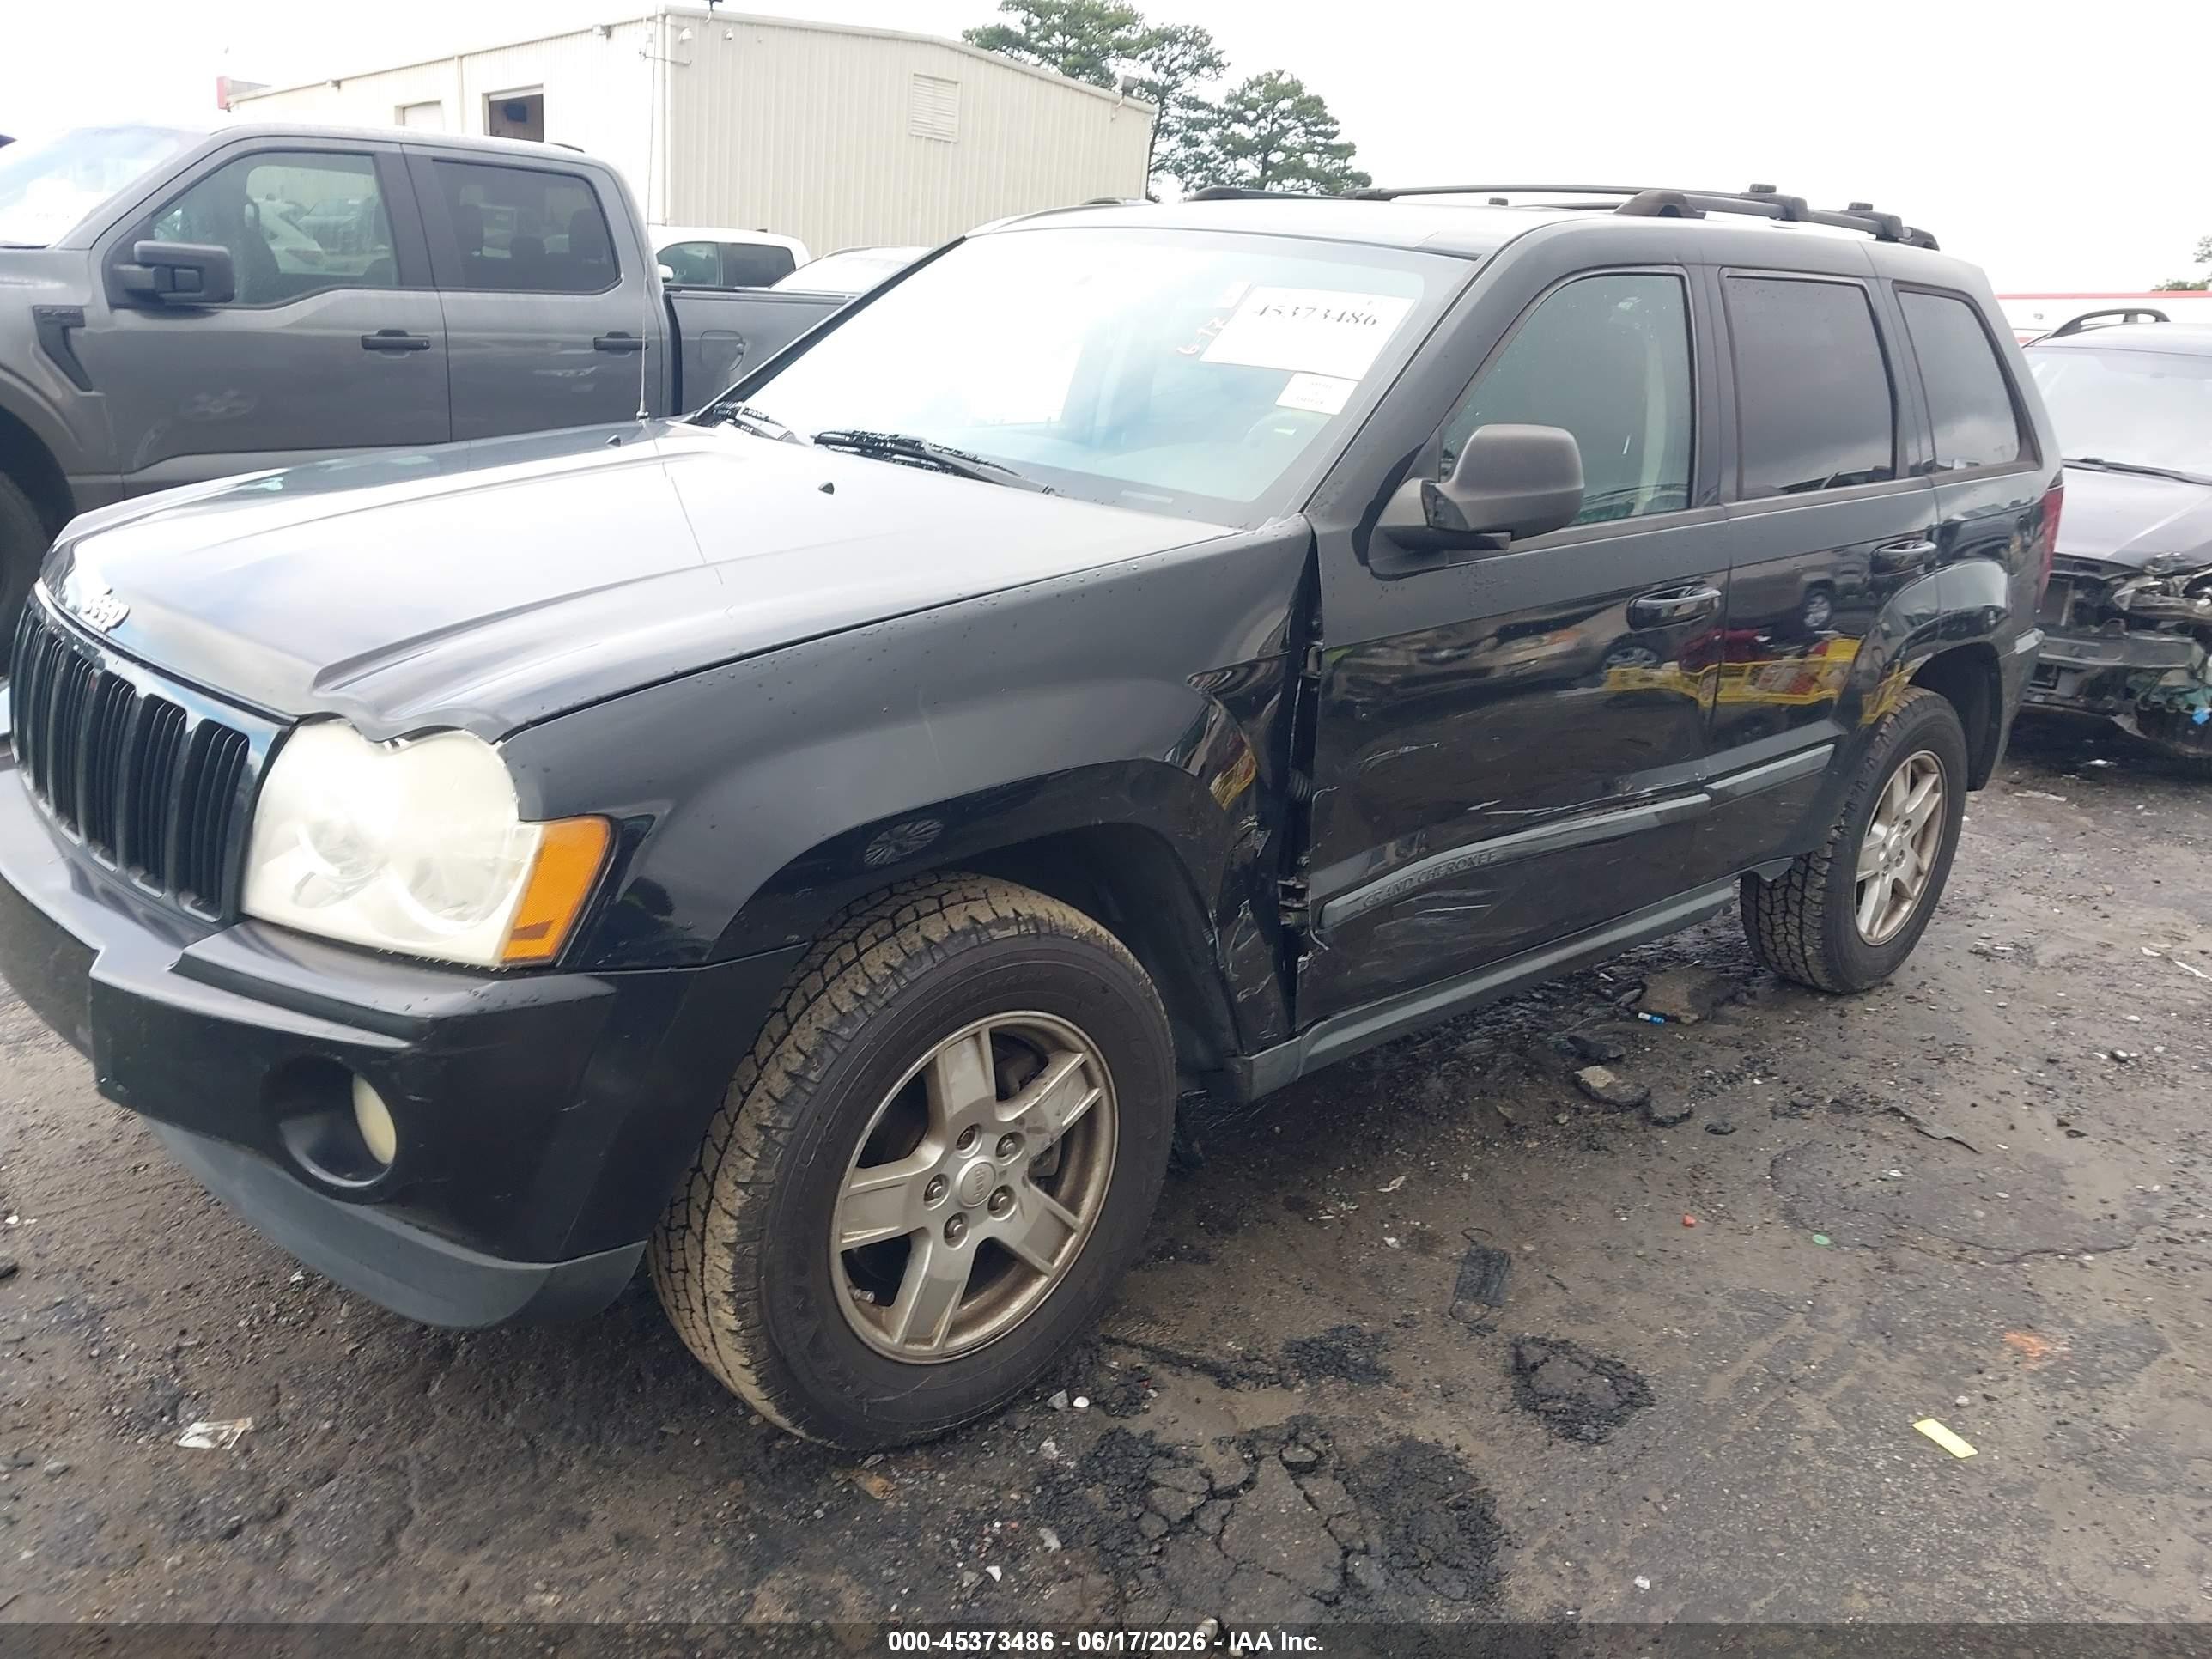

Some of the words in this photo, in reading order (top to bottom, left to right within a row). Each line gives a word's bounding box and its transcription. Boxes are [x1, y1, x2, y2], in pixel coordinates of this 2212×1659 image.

[1254, 303, 1378, 326] 45373486
[1364, 877, 1413, 907] GRAND
[1418, 851, 1498, 880] CHEROKEE
